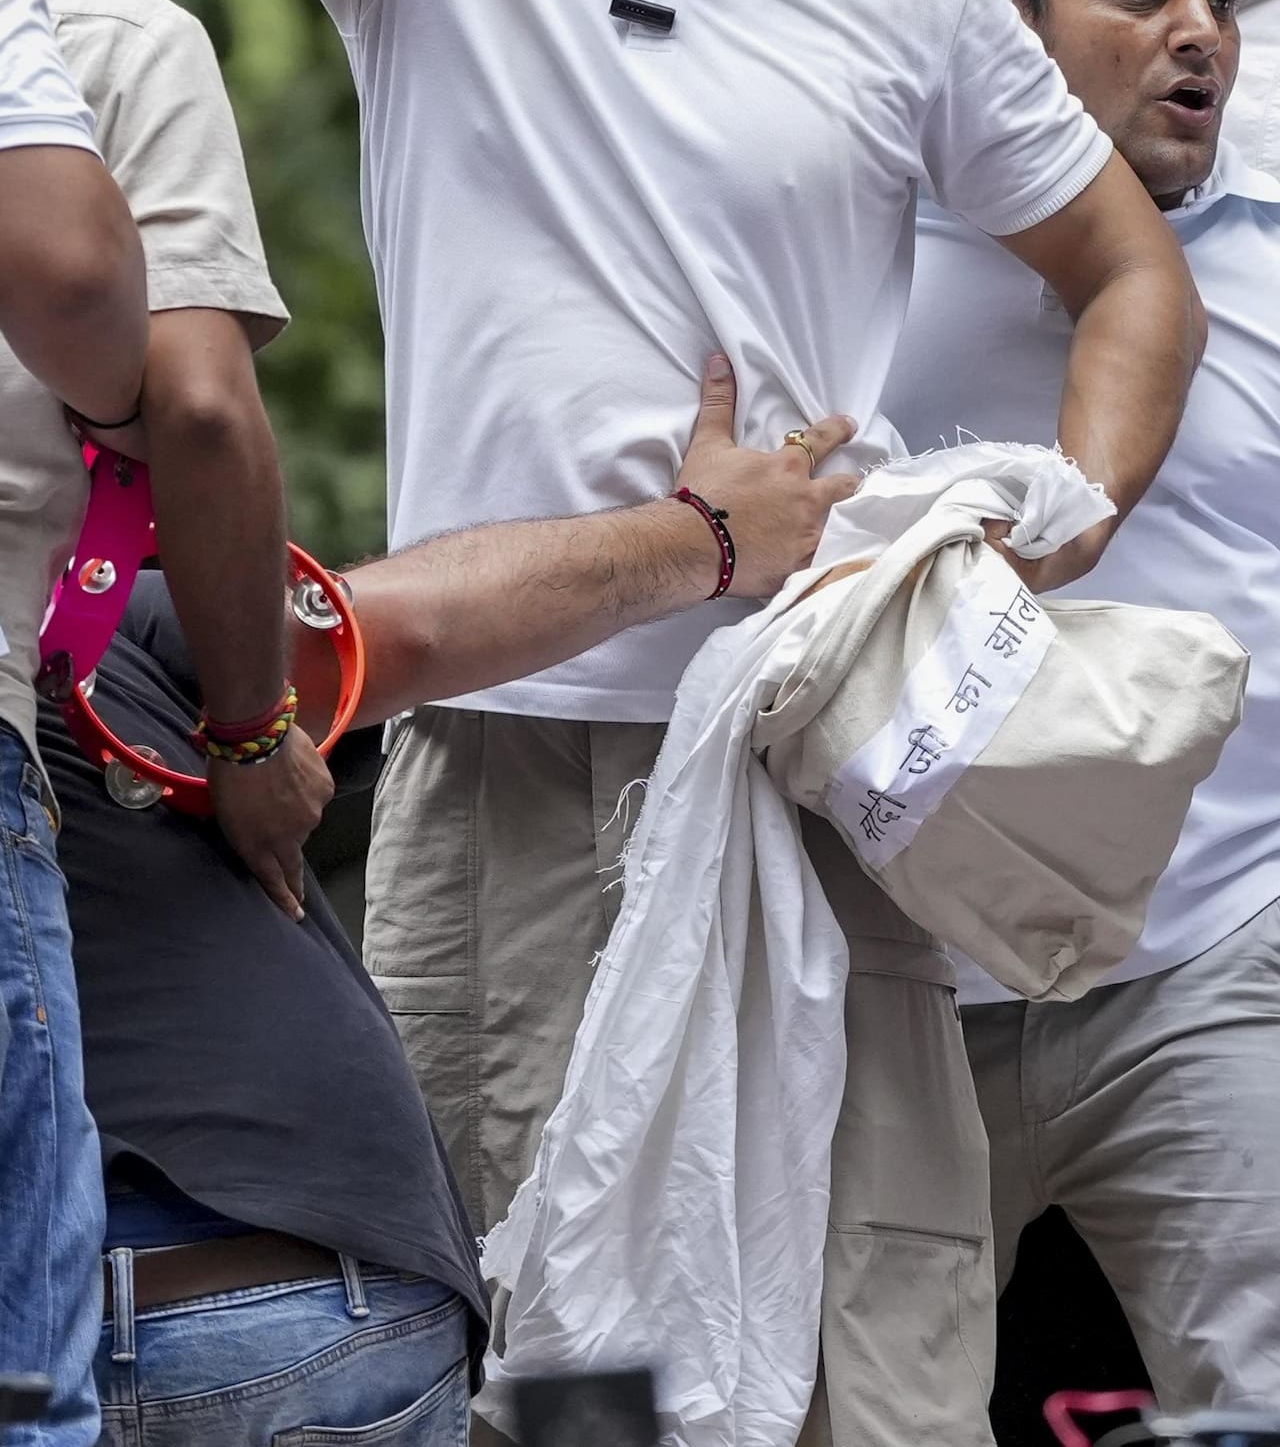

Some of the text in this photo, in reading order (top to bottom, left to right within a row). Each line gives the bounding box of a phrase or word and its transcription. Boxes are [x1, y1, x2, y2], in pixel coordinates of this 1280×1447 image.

[899, 724, 950, 775] जी
[945, 663, 993, 715] का
[984, 584, 1042, 660] झोला
